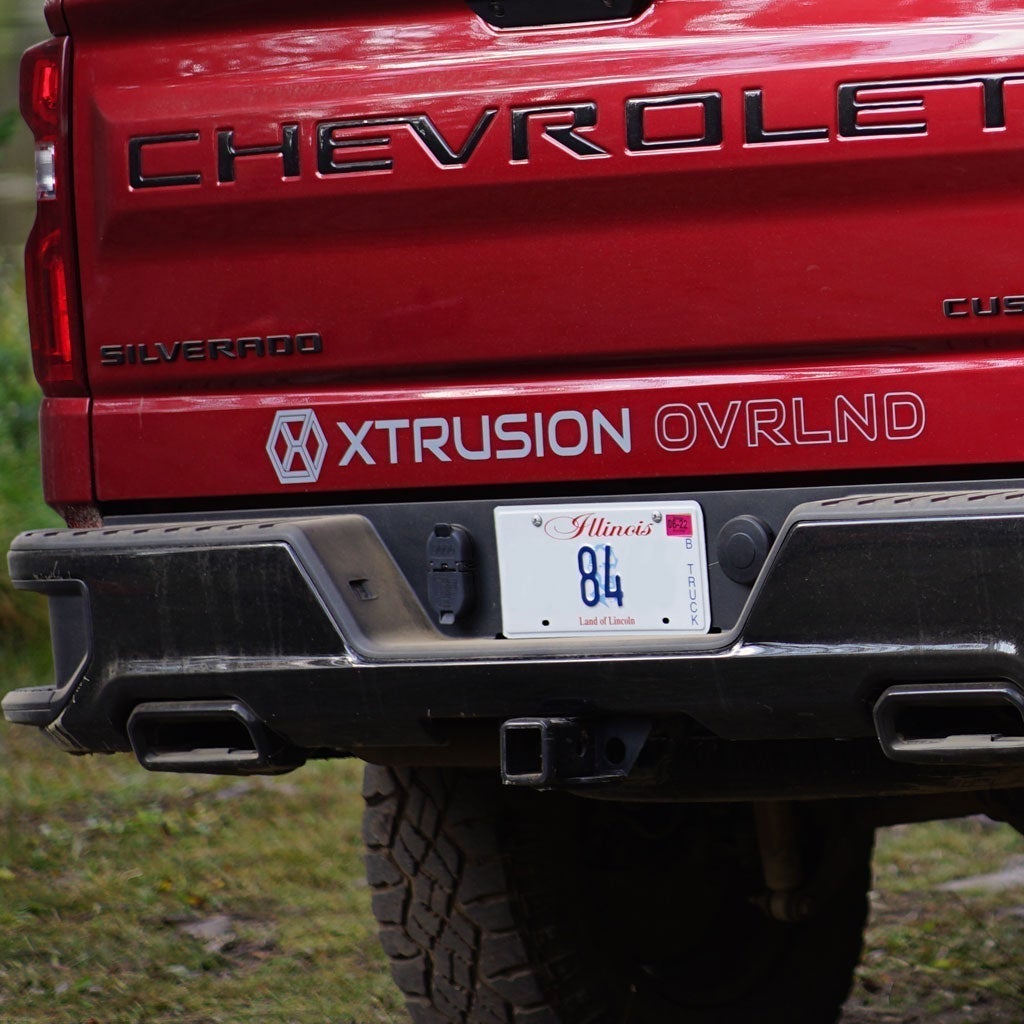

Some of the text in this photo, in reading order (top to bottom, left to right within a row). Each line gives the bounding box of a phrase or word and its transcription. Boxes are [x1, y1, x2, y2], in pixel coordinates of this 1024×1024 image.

[100, 332, 324, 365] SILVERADO
[336, 391, 926, 467] XTRUSION OVRLND
[544, 512, 654, 541] Illinois
[685, 538, 693, 550] B
[577, 544, 624, 608] 84
[579, 616, 636, 626] Land of Lincoln
